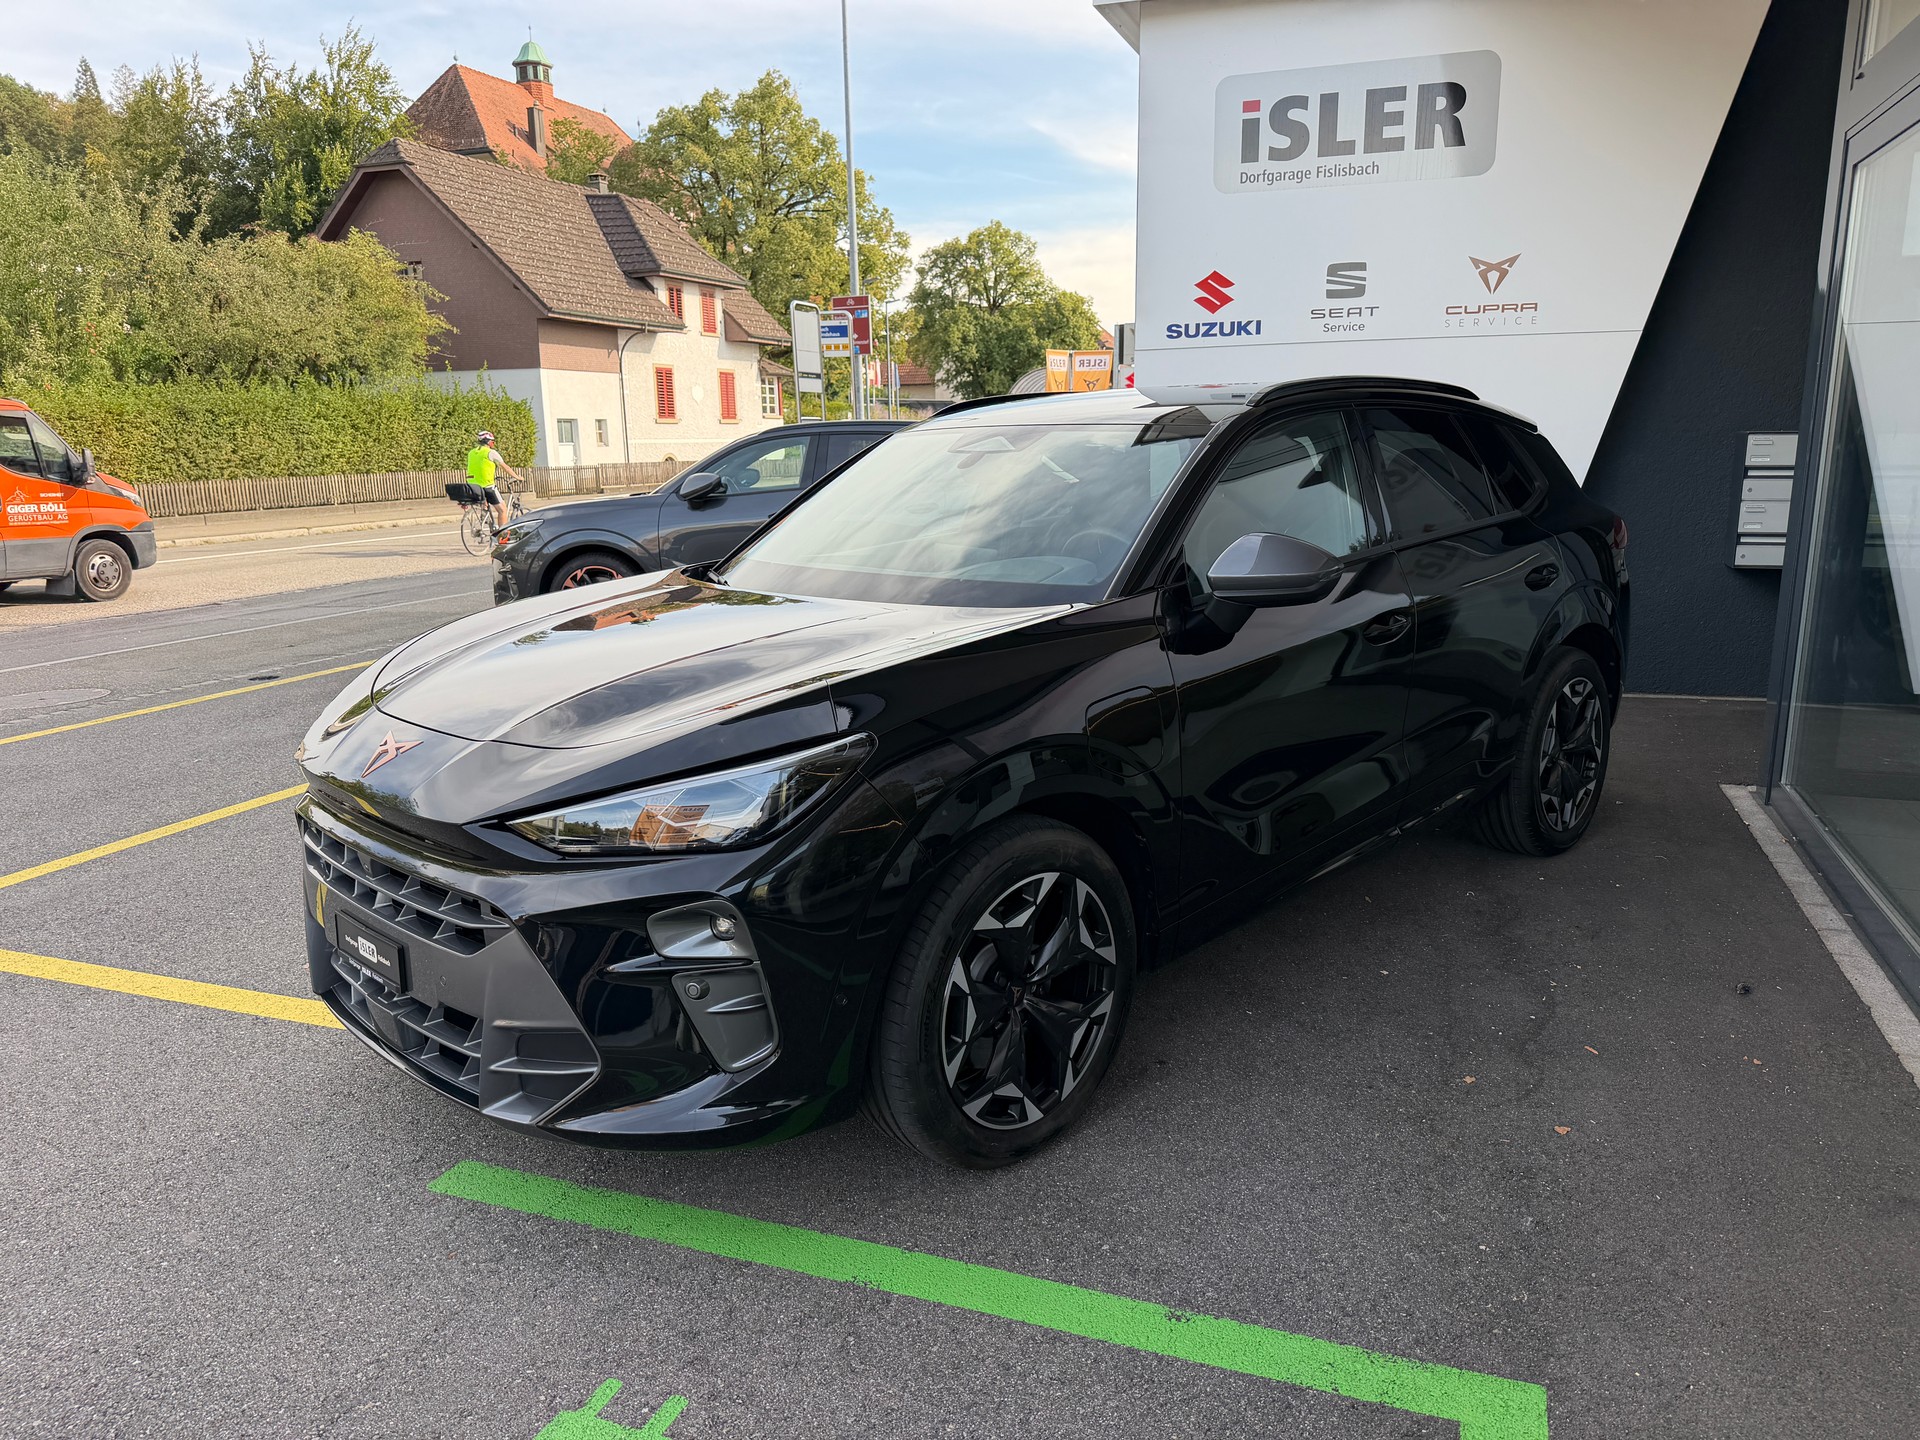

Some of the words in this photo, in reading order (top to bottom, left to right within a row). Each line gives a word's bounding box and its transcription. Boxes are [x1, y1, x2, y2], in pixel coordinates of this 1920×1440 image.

[1240, 170, 1312, 186] Dorfgarage
[1316, 161, 1380, 179] Fislisbach
[1310, 305, 1380, 320] SEAT
[1445, 302, 1539, 315] CUPRA
[1322, 321, 1365, 333] Service
[1444, 315, 1538, 328] SERVICE
[1166, 319, 1262, 340] SUZUKI
[7, 504, 39, 513] GIGER
[40, 502, 66, 512] BÖLL
[8, 513, 54, 522] GERÜSTBAU
